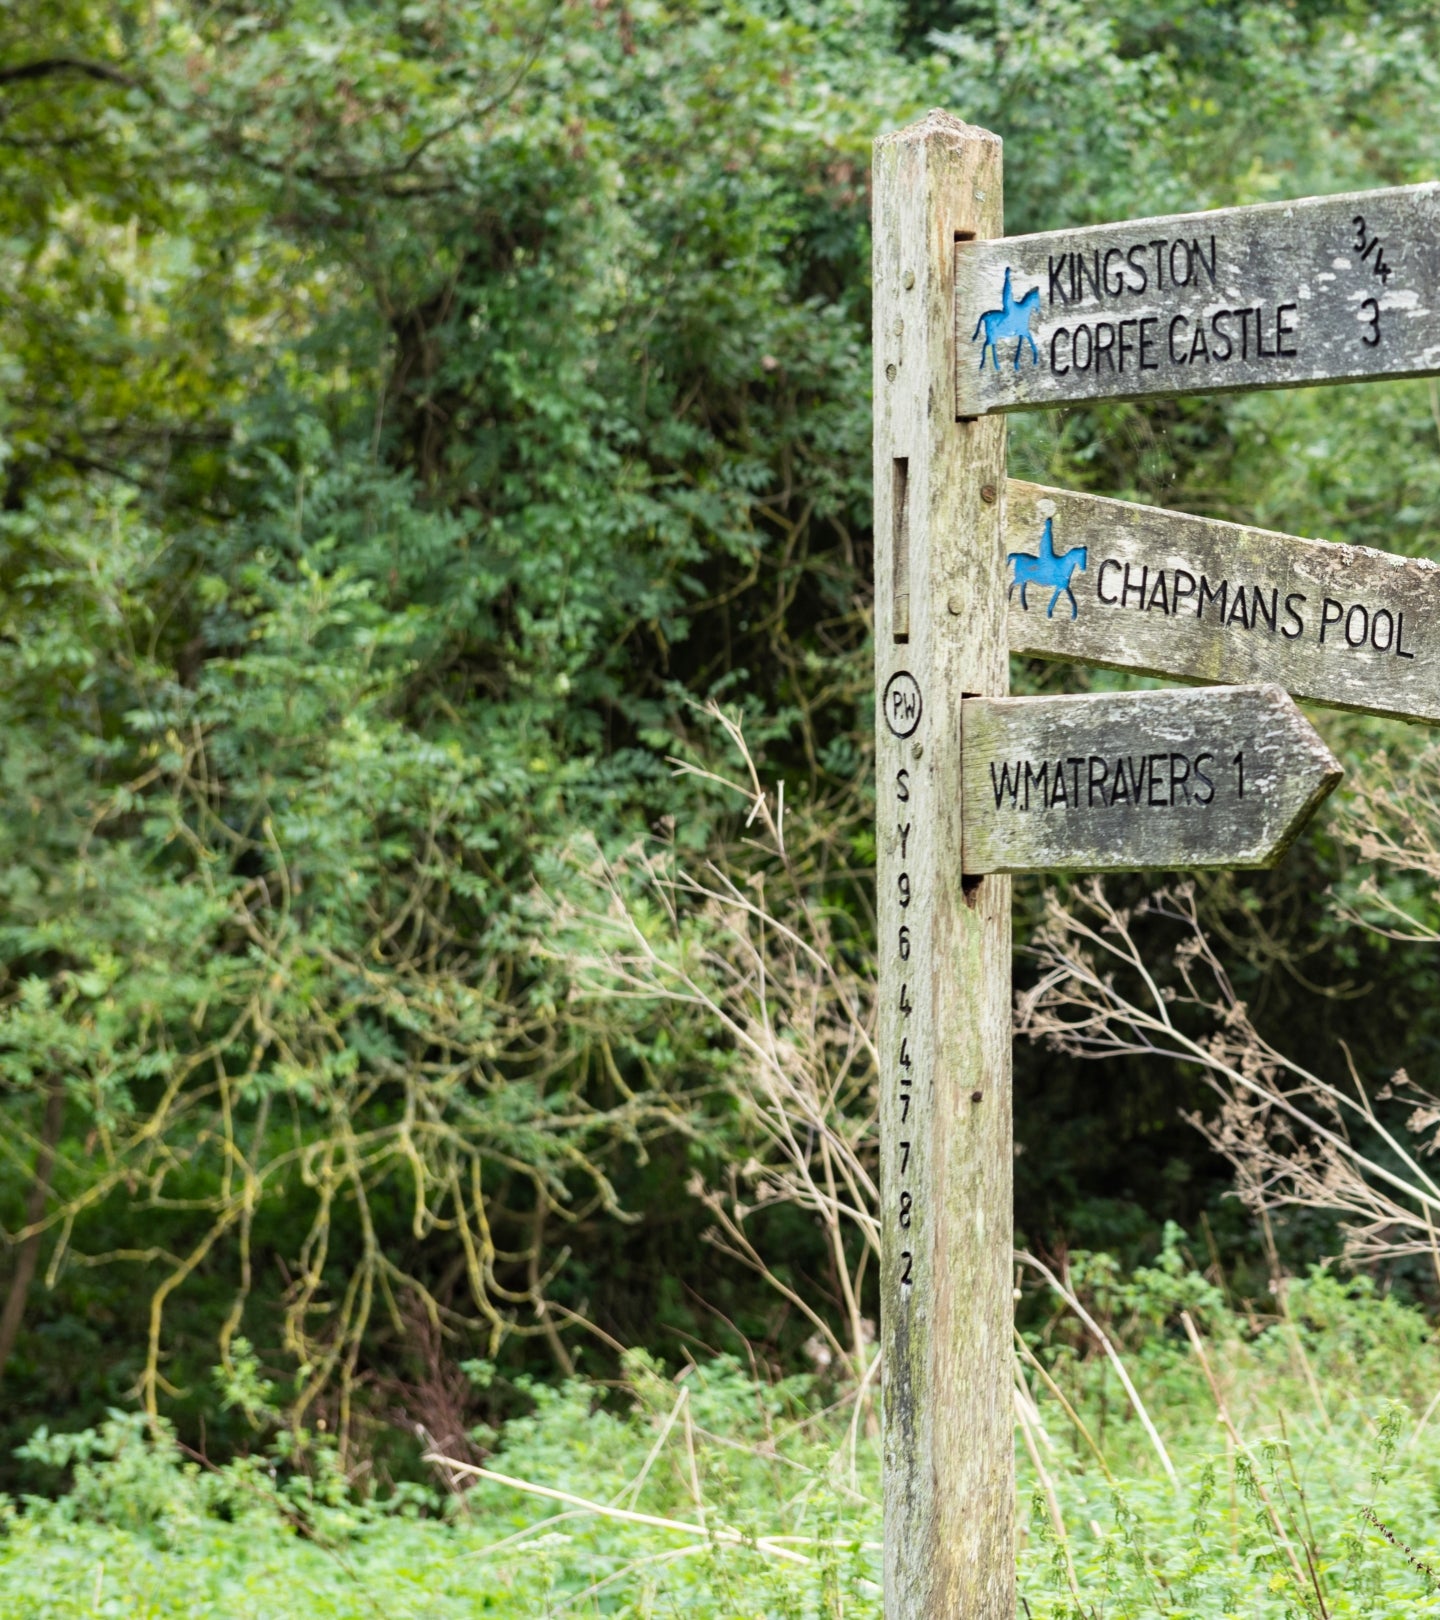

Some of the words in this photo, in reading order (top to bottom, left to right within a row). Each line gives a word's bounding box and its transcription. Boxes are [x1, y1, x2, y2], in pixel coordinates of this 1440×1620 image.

[1048, 235, 1217, 304] KINGSTON
[1051, 317, 1159, 377] CORFE
[1168, 304, 1298, 365] CASTLE
[1361, 298, 1381, 348] 3
[1097, 558, 1306, 639] CHAPMANS
[1319, 598, 1415, 660] POOL
[1232, 751, 1244, 799] 1
